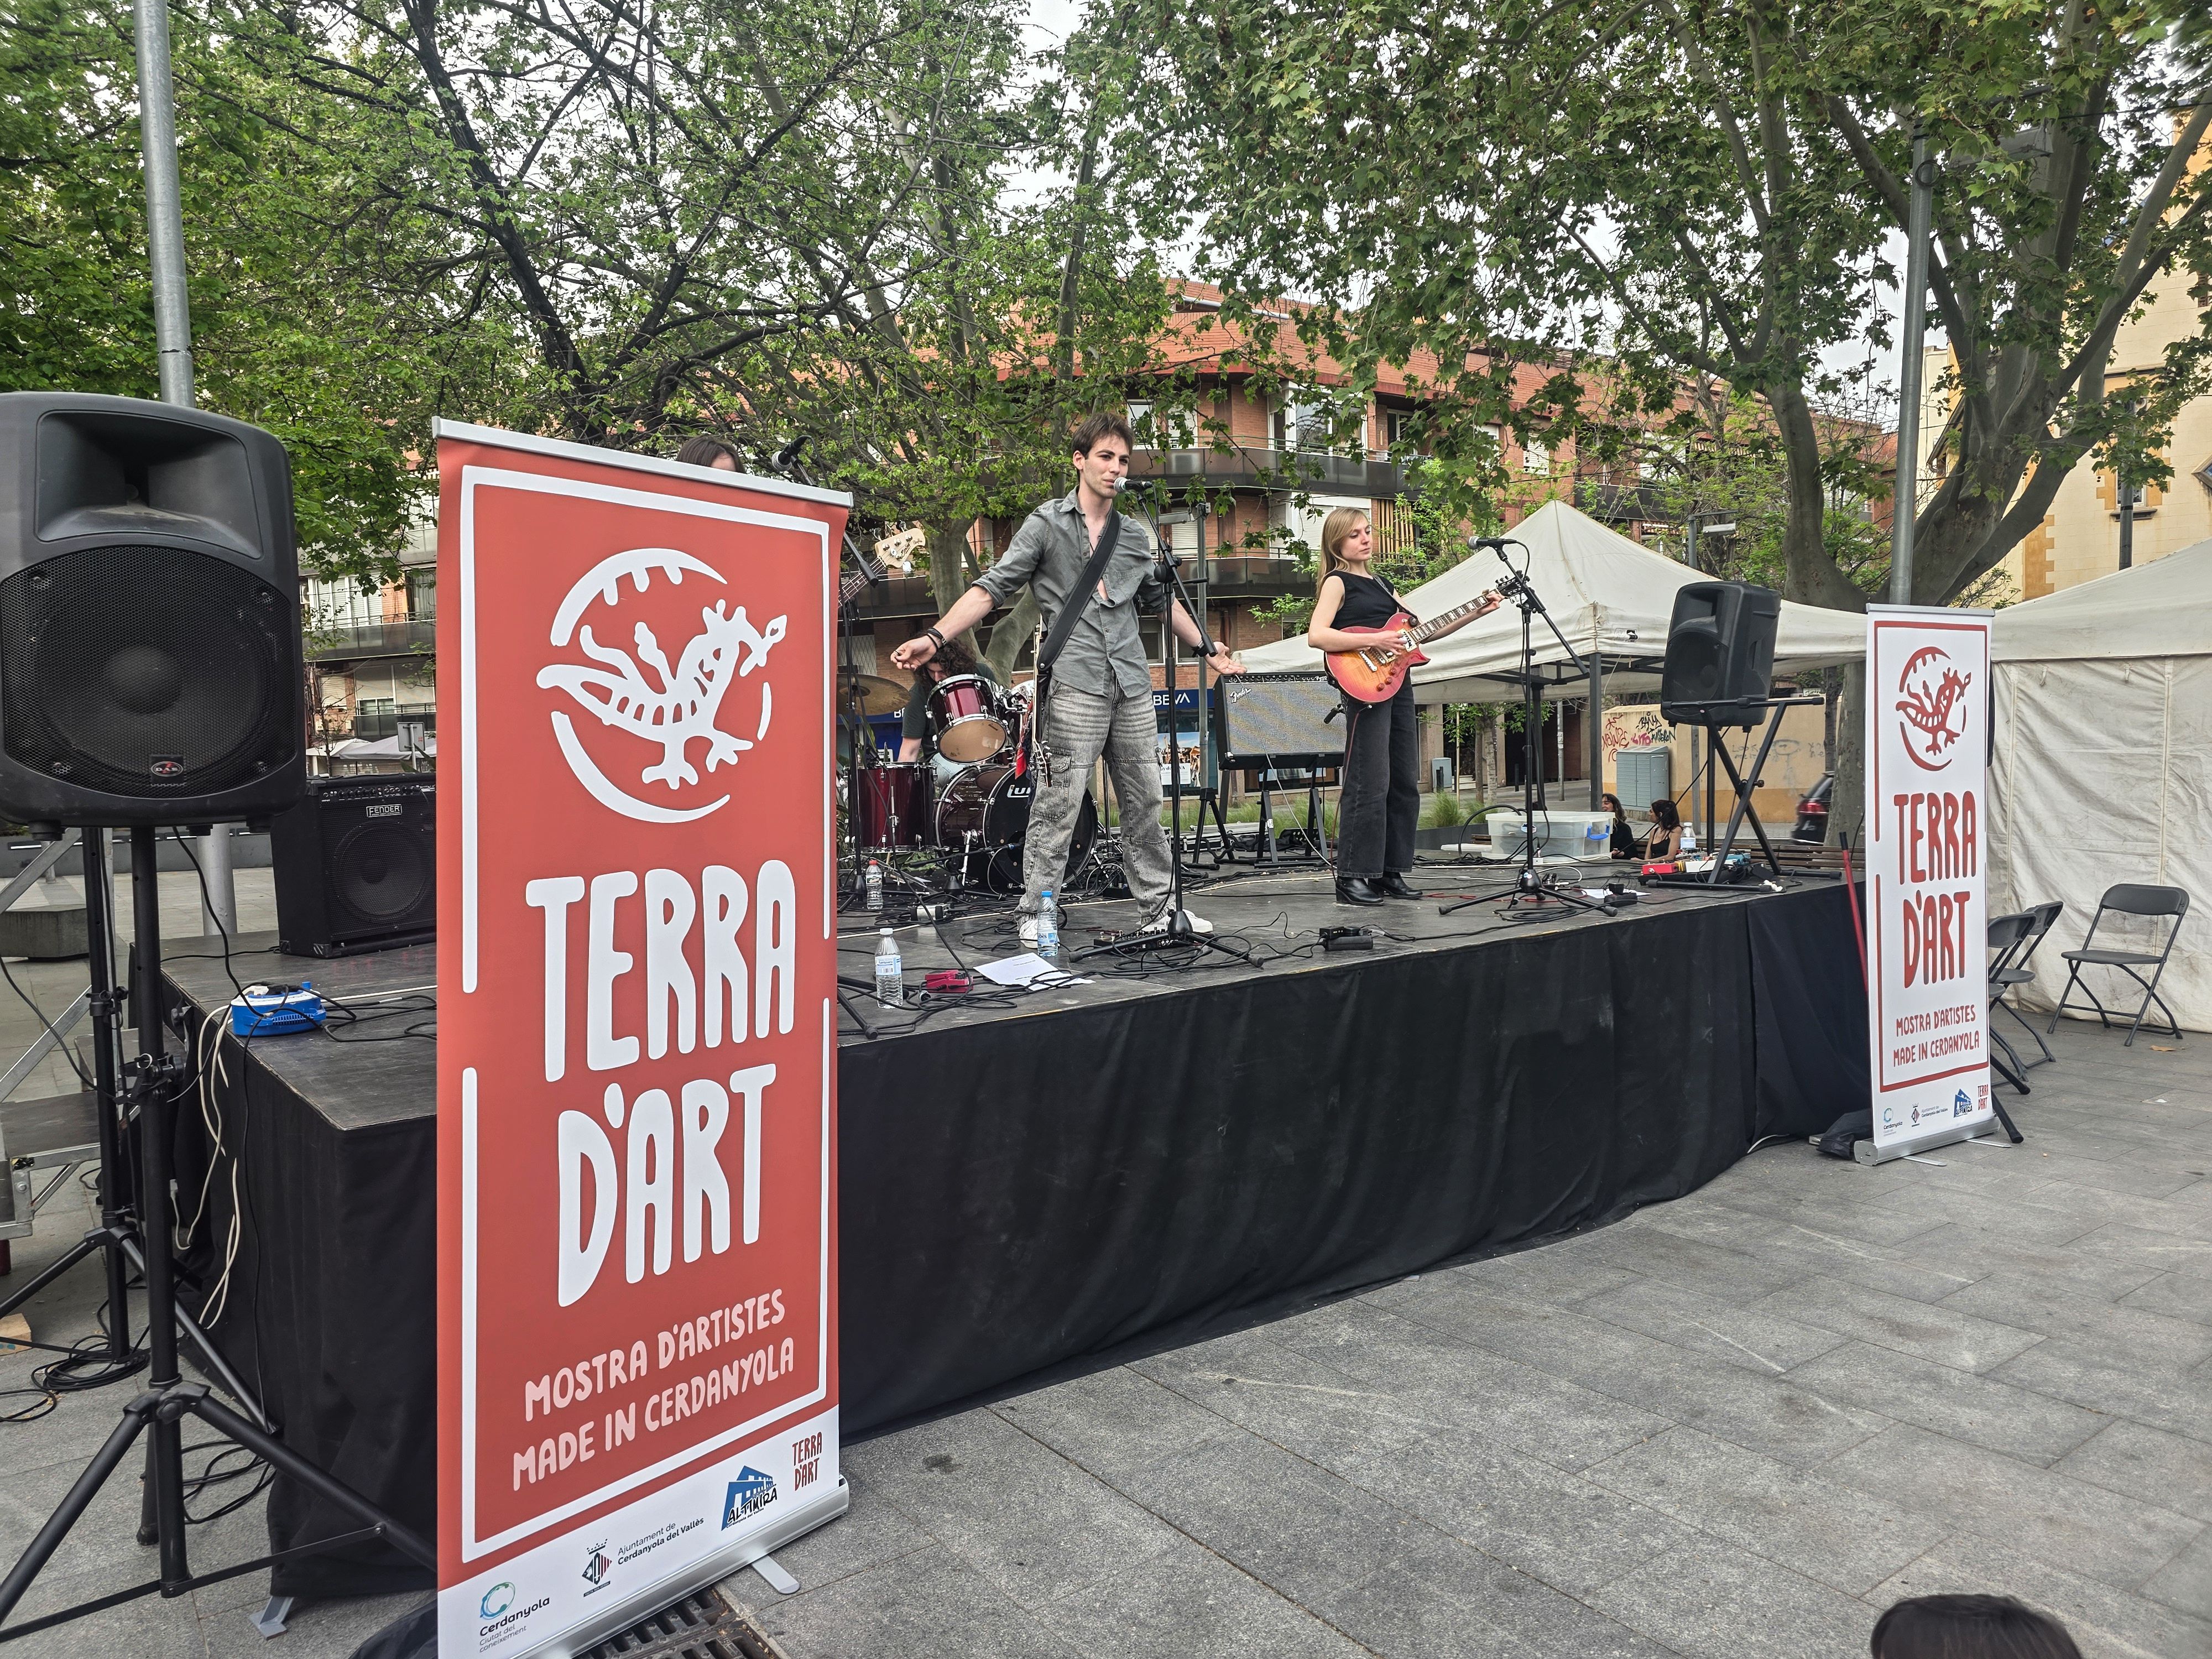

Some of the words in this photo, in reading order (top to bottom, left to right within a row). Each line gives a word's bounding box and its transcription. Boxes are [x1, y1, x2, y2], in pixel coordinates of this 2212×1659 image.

[369, 805, 400, 816] FENDER
[1893, 790, 1976, 885] TERRA
[1903, 889, 1970, 989] D'ART
[525, 859, 796, 1082] TERRA
[1896, 1013, 1931, 1037] MOSTRA
[1933, 1004, 1976, 1029] D'ARTISTES
[1893, 1045, 1916, 1067] MADE
[1918, 1041, 1928, 1061] IN
[1930, 1030, 1980, 1058] CERDANYOLA
[558, 1063, 776, 1307] D'ART
[525, 1340, 648, 1422] MOSTRA
[658, 1288, 785, 1369] D'ARTISTES
[513, 1421, 595, 1491] MADE
[605, 1402, 636, 1452] IN
[644, 1337, 794, 1432] CERDANYOLA
[792, 1431, 822, 1467] TERRA
[795, 1457, 820, 1491] D'ART
[728, 1487, 778, 1522] ALTIMIRA
[618, 1527, 664, 1556] Ajuntament
[665, 1522, 676, 1532] de
[618, 1538, 665, 1565] Cerdanyola
[666, 1529, 680, 1542] del
[681, 1517, 705, 1534] Vallès
[479, 1597, 550, 1636] Cerdanyola
[479, 1631, 502, 1646] Ciutat
[504, 1624, 515, 1634] del
[479, 1625, 527, 1653] coneixement
